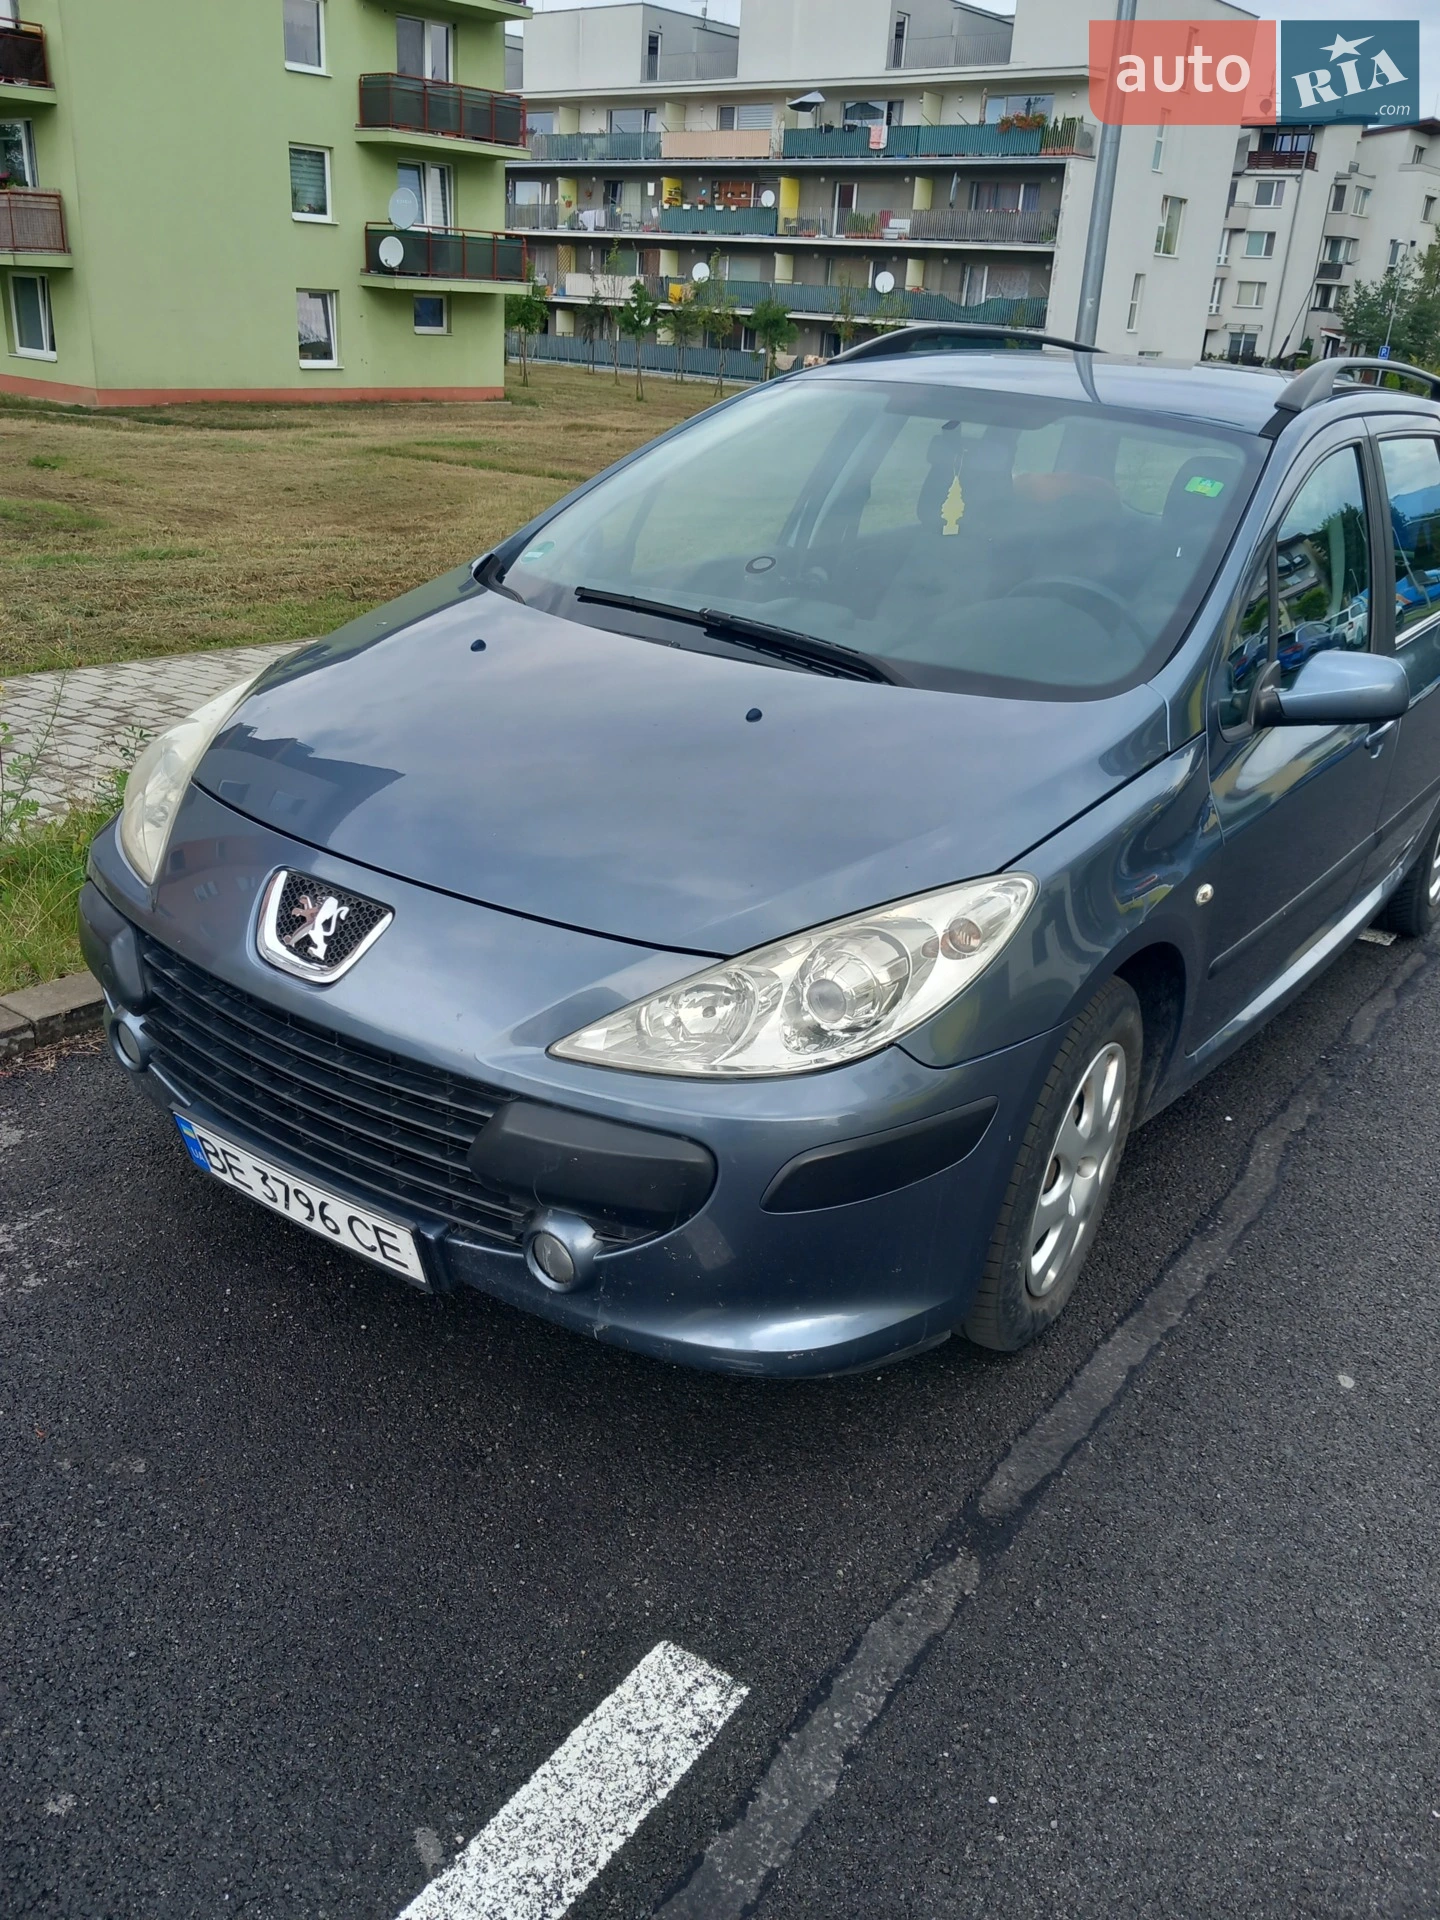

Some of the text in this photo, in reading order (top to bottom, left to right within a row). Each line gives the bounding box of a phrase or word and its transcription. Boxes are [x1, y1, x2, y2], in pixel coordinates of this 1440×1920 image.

[190, 1146, 207, 1164] UA
[197, 1134, 409, 1269] BE 3796 CE
